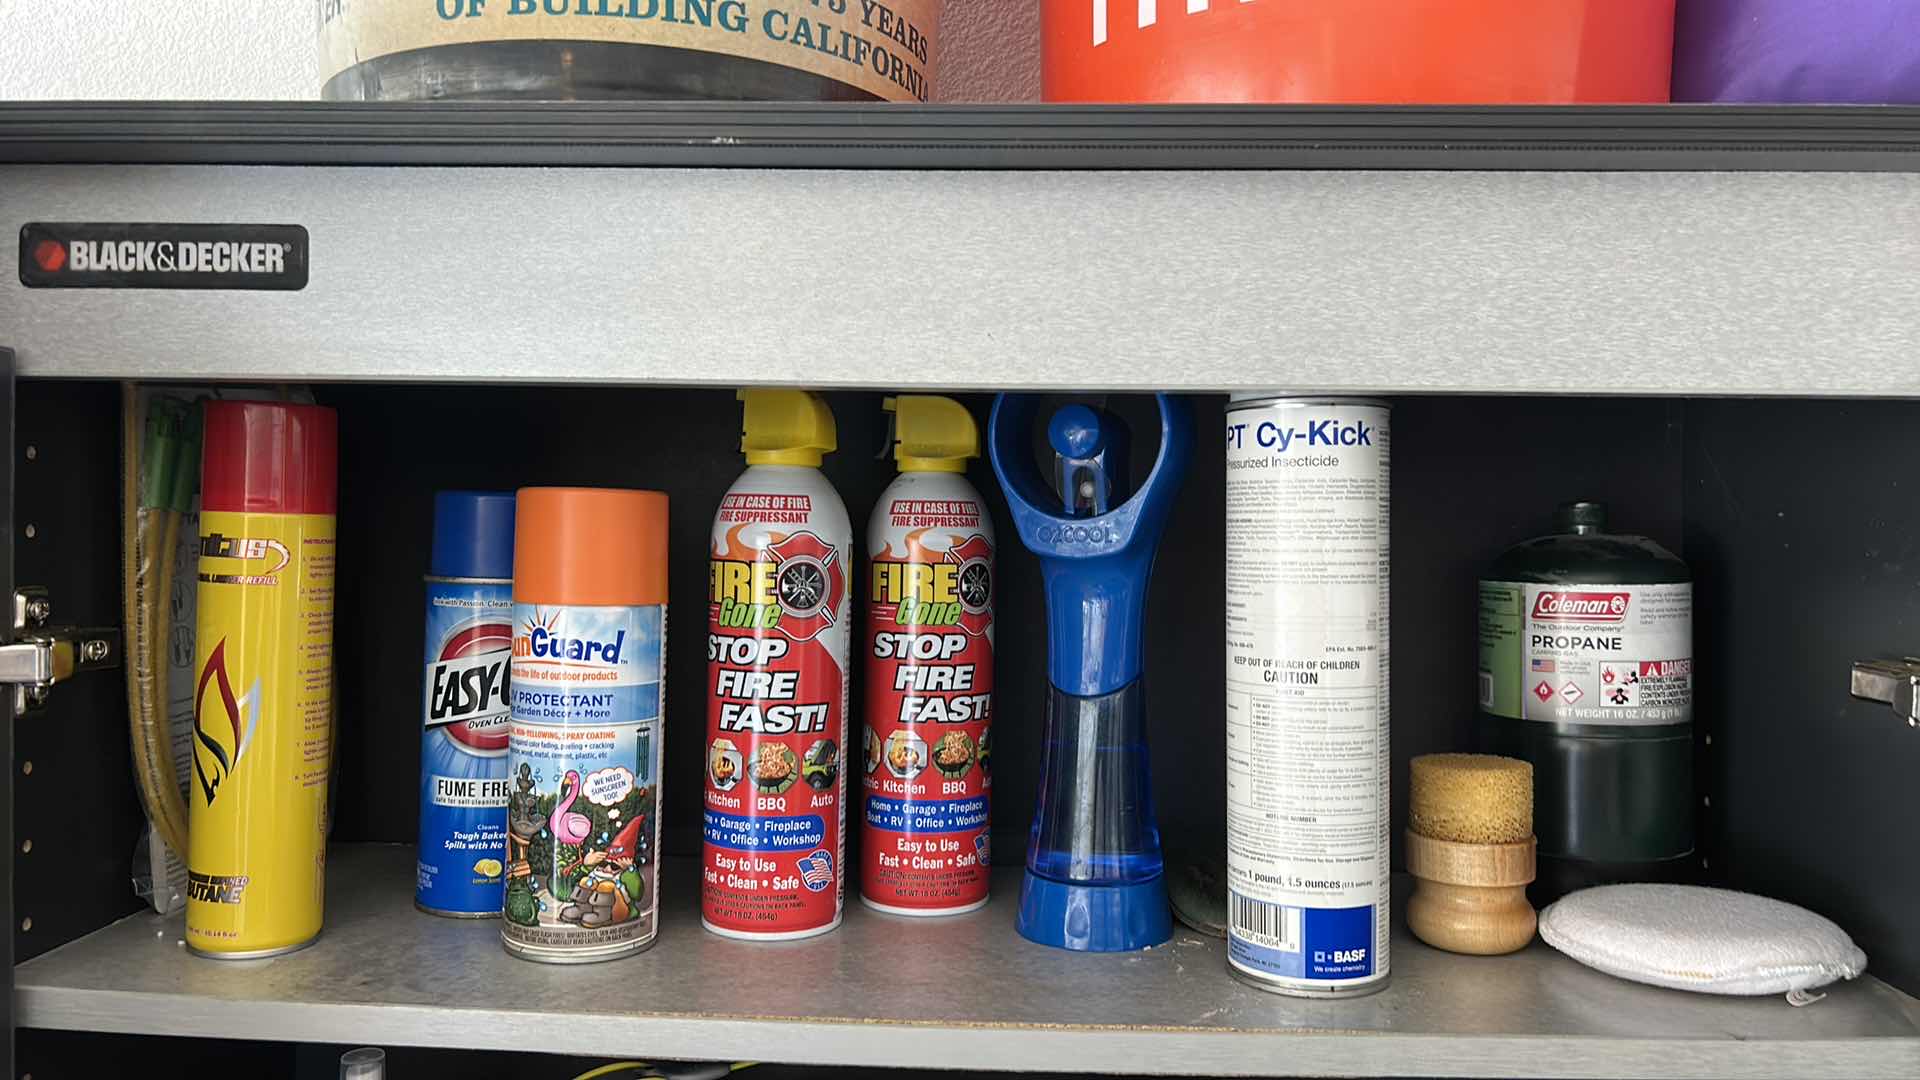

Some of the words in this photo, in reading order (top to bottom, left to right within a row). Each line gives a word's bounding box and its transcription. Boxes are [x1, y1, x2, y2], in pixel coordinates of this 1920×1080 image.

[860, 0, 927, 65] YEARS
[762, 9, 929, 103] CALIFORNIA
[1256, 420, 1371, 452] Cy-Kick
[1272, 456, 1339, 468] Insecticide
[735, 496, 745, 508] IN
[746, 496, 770, 508] CASE
[772, 497, 786, 508] OF
[787, 498, 810, 510] FIRE
[894, 502, 910, 513] USE
[912, 502, 922, 513] IN
[924, 502, 948, 514] CASE
[948, 503, 960, 514] OF
[962, 503, 978, 514] FIRE
[720, 510, 734, 521] FIRE
[736, 511, 808, 524] SUPPRESSANT
[892, 516, 911, 527] FIRE
[913, 516, 980, 528] SUPPRESSANT
[872, 562, 959, 604] FIRE
[487, 600, 508, 608] Clean
[1539, 593, 1608, 614] Coleman
[719, 597, 782, 628] Gone
[895, 597, 962, 626] Gone
[707, 633, 789, 666] STOP
[873, 631, 966, 660] STOP
[1532, 635, 1622, 650] PROPANE
[1234, 656, 1246, 666] KEEP
[1248, 657, 1260, 666] OUT
[1263, 659, 1272, 668] OF
[1275, 660, 1304, 669] RACH
[1307, 660, 1318, 670] OF
[1320, 660, 1360, 670] CHILDREN
[530, 669, 540, 680] life
[542, 670, 549, 680] of
[582, 671, 618, 682] products
[894, 664, 976, 691] FIRE
[1264, 670, 1318, 684] CAUTION
[716, 669, 800, 700] FIRE
[520, 692, 614, 706] PROTECTANT
[516, 705, 541, 716] Garden
[544, 708, 572, 718] Décor
[585, 709, 610, 718] More
[899, 692, 992, 724] FAST!
[1575, 708, 1610, 718] WEIGHT
[468, 717, 492, 729] OVEN
[719, 702, 830, 734] FAST!
[586, 731, 616, 740] COATING
[560, 742, 582, 750] peling
[588, 742, 615, 750] cracking
[576, 752, 598, 760] plastic,
[594, 777, 604, 786] WE
[606, 773, 622, 783] NEED
[438, 780, 476, 798] FUME
[592, 780, 626, 796] SUNSCREEN
[883, 780, 926, 794] Kitchen
[942, 781, 967, 795] BBQ
[708, 791, 740, 808] Kitchen
[757, 797, 786, 812] BBQ
[810, 794, 834, 808] Auto
[871, 800, 891, 812] Home
[902, 804, 937, 816] Garage
[948, 801, 982, 813] Fireplace
[720, 817, 751, 832] Garage
[764, 820, 812, 833] Fireplace
[890, 816, 904, 826] RV
[916, 818, 944, 828] Office
[454, 832, 480, 842] Tough
[731, 833, 759, 846] Office
[772, 833, 821, 846] Workshop
[444, 840, 466, 850] Spills
[468, 841, 488, 850] with
[490, 841, 503, 849] No
[897, 838, 922, 854] Easy
[925, 840, 936, 852] to
[940, 838, 960, 852] Use
[716, 853, 737, 871] Easy
[740, 857, 751, 870] to
[754, 858, 776, 872] Use
[880, 852, 900, 868] Fast
[912, 856, 944, 869] Clean
[956, 852, 976, 868] Safe
[727, 874, 758, 889] Clean
[772, 875, 800, 890] Safe
[1248, 870, 1252, 879] 1
[1254, 872, 1285, 886] pound,
[1305, 880, 1340, 888] ounces
[188, 880, 242, 904] BUTANE
[1334, 948, 1366, 963] BASF
